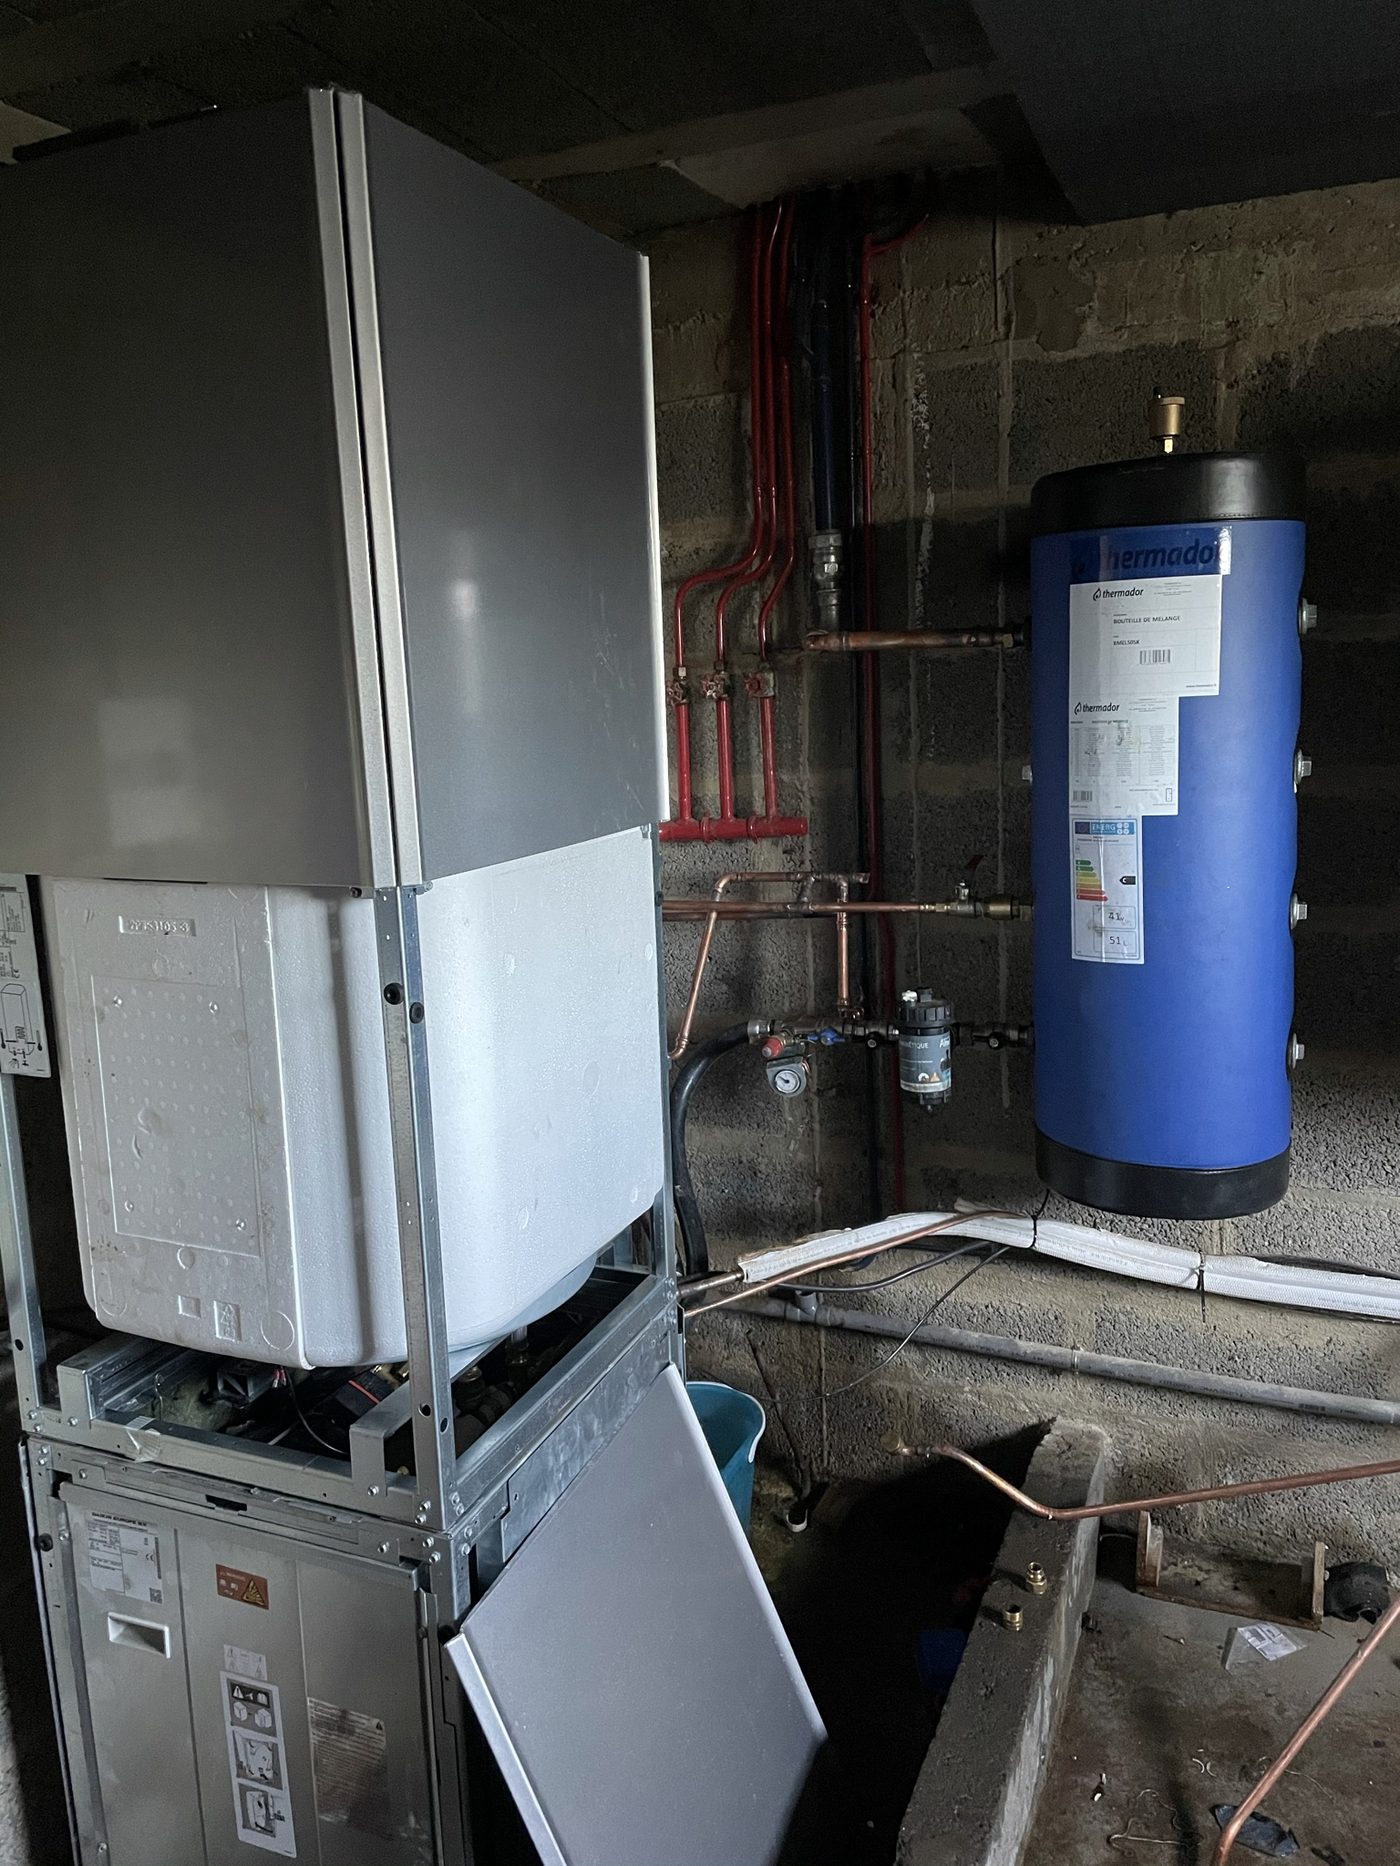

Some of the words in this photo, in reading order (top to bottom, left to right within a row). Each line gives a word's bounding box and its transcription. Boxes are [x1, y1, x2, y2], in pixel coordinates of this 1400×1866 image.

[1102, 587, 1144, 600] thermador
[1113, 616, 1142, 624] BOUTEILLE
[1082, 702, 1120, 713] thermador
[1109, 936, 1121, 945] 51
